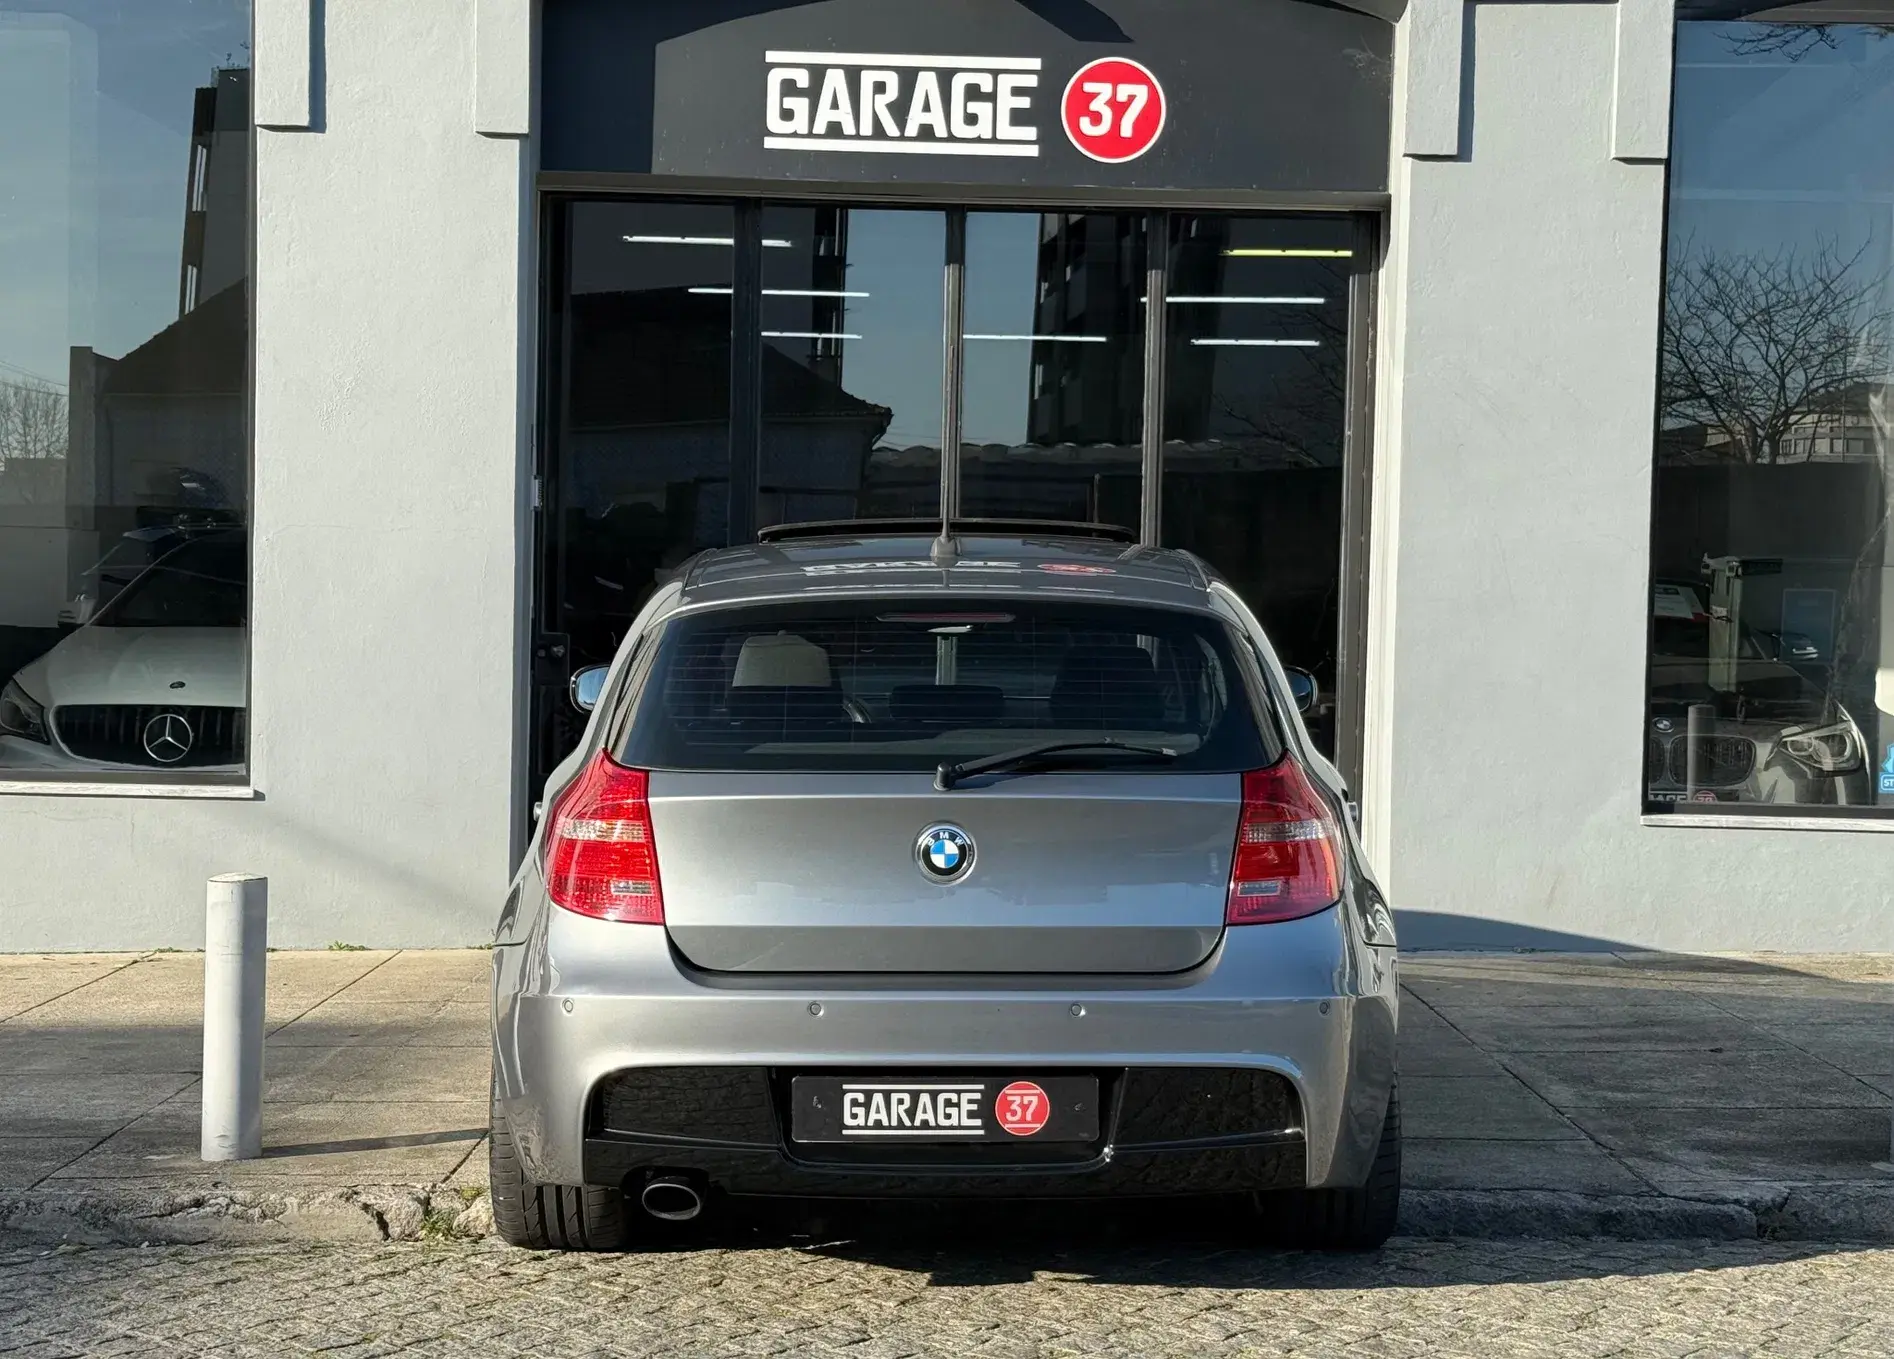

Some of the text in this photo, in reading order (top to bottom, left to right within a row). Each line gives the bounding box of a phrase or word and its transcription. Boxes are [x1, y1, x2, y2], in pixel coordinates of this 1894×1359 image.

[766, 67, 1149, 141] GARAGE 37
[927, 831, 965, 847] BMW
[843, 1092, 1039, 1127] GARAGE 37
